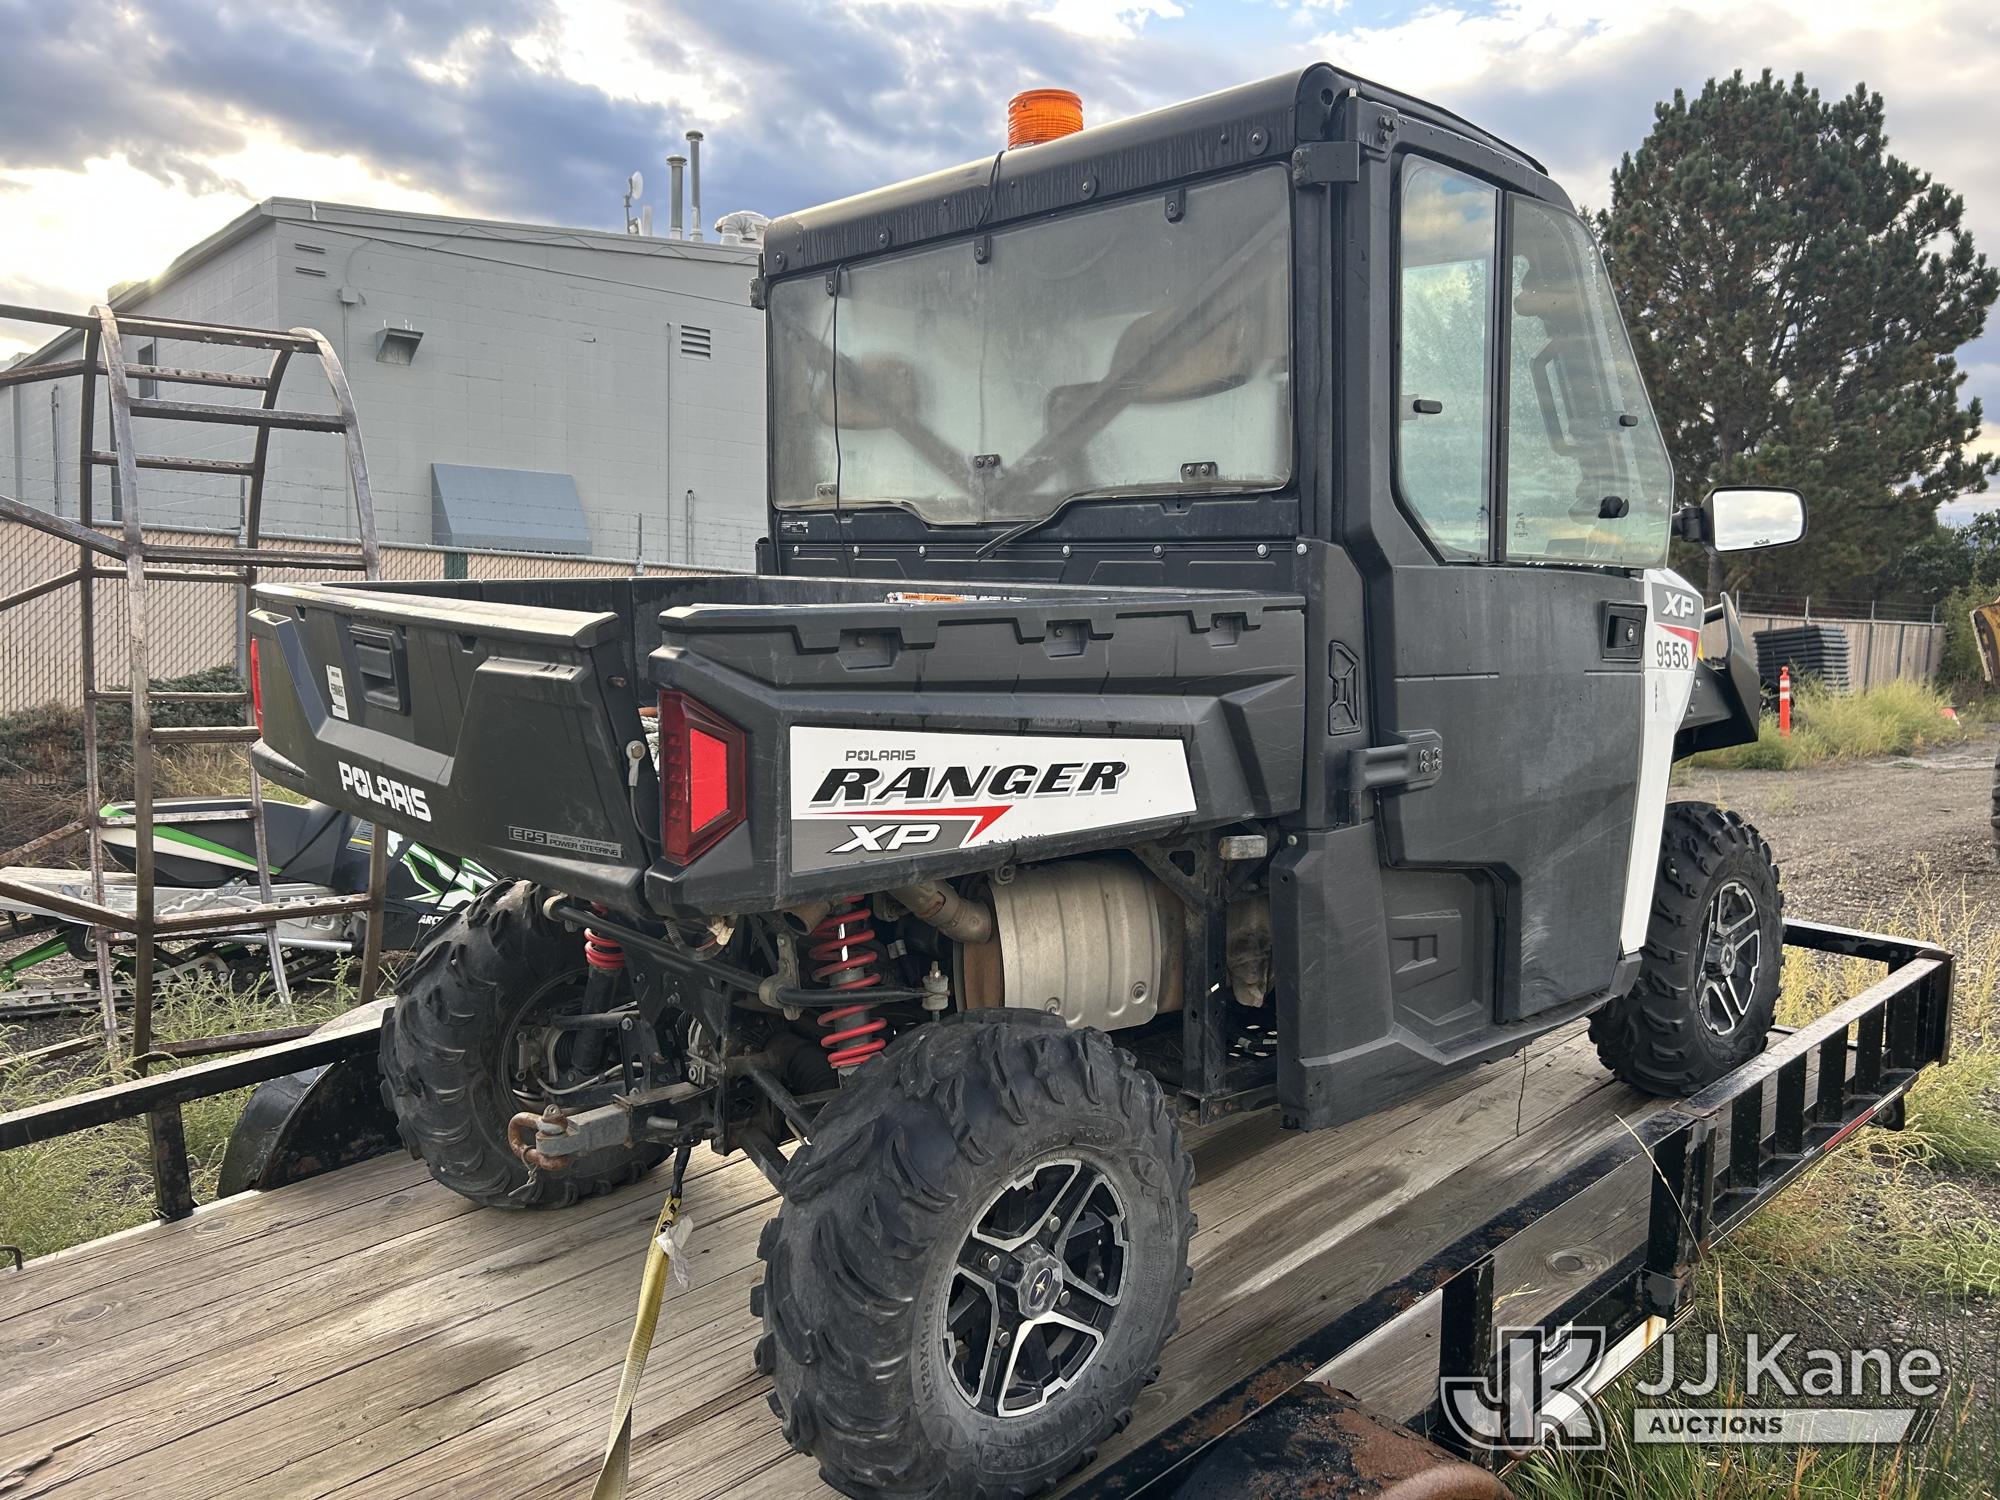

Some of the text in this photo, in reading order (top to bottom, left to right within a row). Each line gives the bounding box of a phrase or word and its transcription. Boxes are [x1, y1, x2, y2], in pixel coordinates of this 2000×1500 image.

[1661, 591, 1695, 618] XP
[1656, 640, 1690, 669] 9558
[845, 749, 916, 762] POLARIS
[338, 761, 432, 822] POLARIS
[808, 761, 1130, 808] RANGER
[513, 829, 544, 843] EPS
[550, 839, 578, 849] POWER
[580, 845, 619, 856] STEERING
[826, 822, 942, 854] XP
[418, 914, 445, 925] ARC
